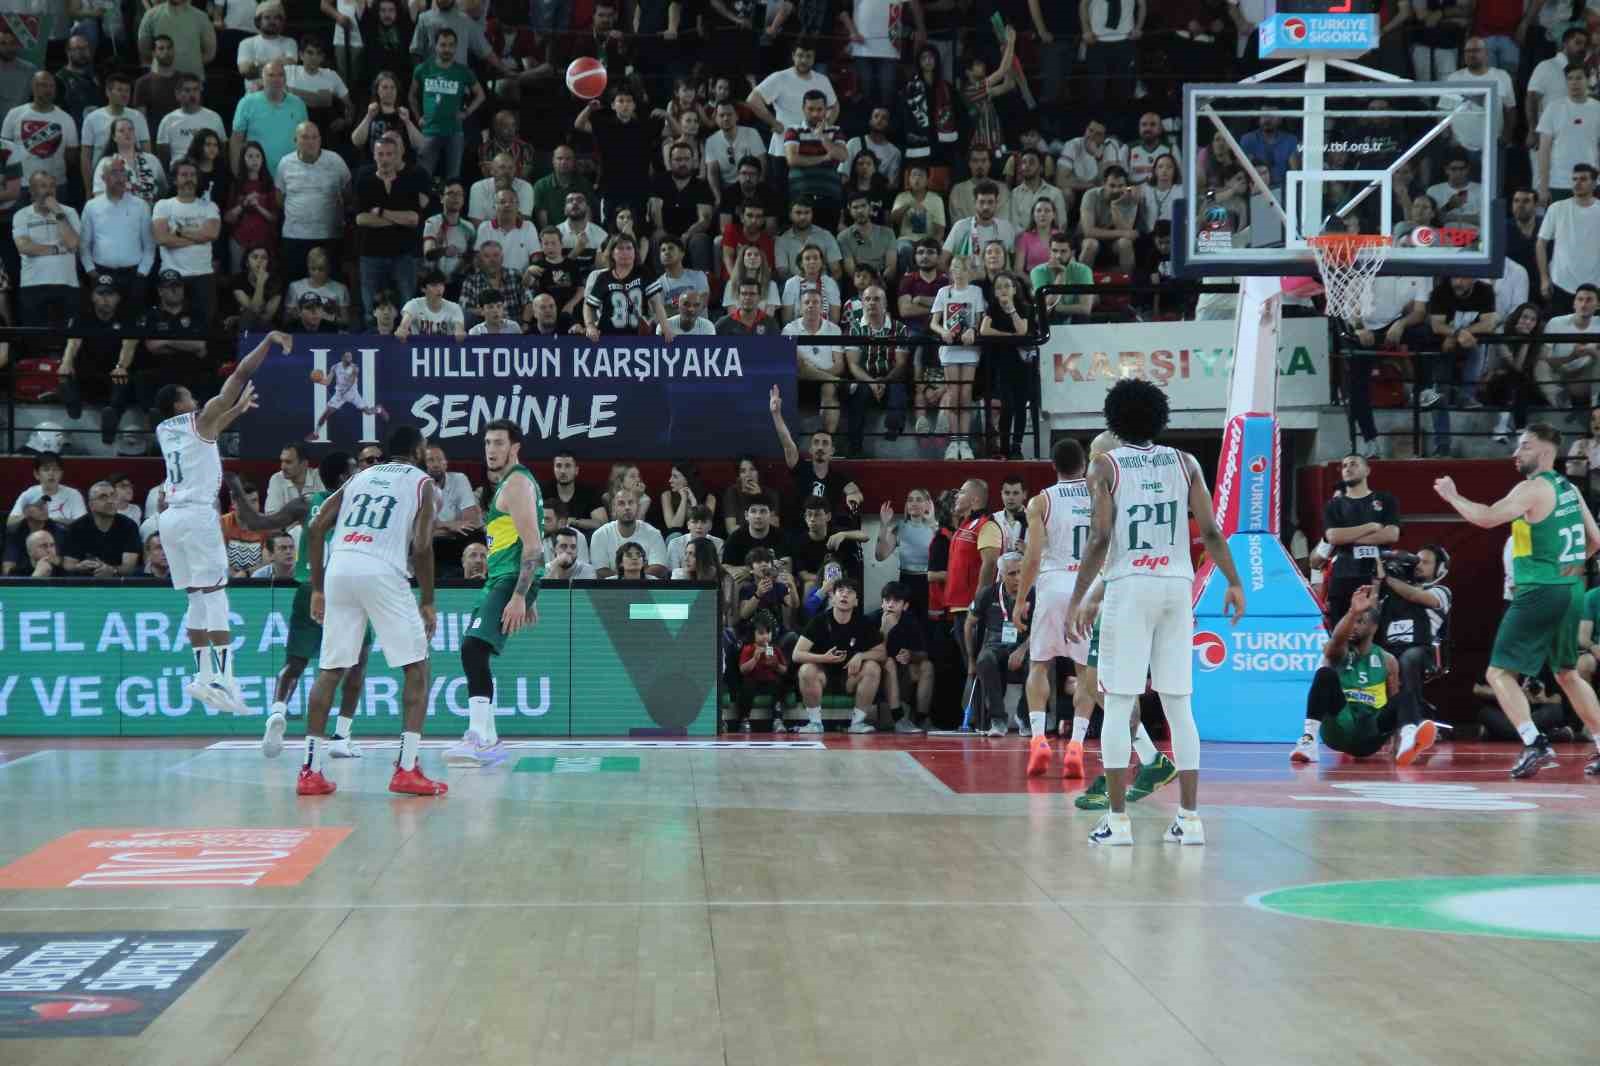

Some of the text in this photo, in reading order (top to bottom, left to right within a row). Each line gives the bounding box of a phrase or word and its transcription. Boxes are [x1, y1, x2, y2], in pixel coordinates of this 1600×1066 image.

[411, 347, 743, 382] HILLTOWN KARŞIYAKA
[1053, 346, 1317, 387] KARŞIYA
[411, 384, 618, 439] SENİNLE
[344, 493, 398, 529] 33
[1127, 500, 1178, 551] 24
[1558, 523, 1586, 561] 23
[19, 610, 85, 652] EL
[31, 675, 103, 717] VE
[1358, 671, 1368, 684] 5
